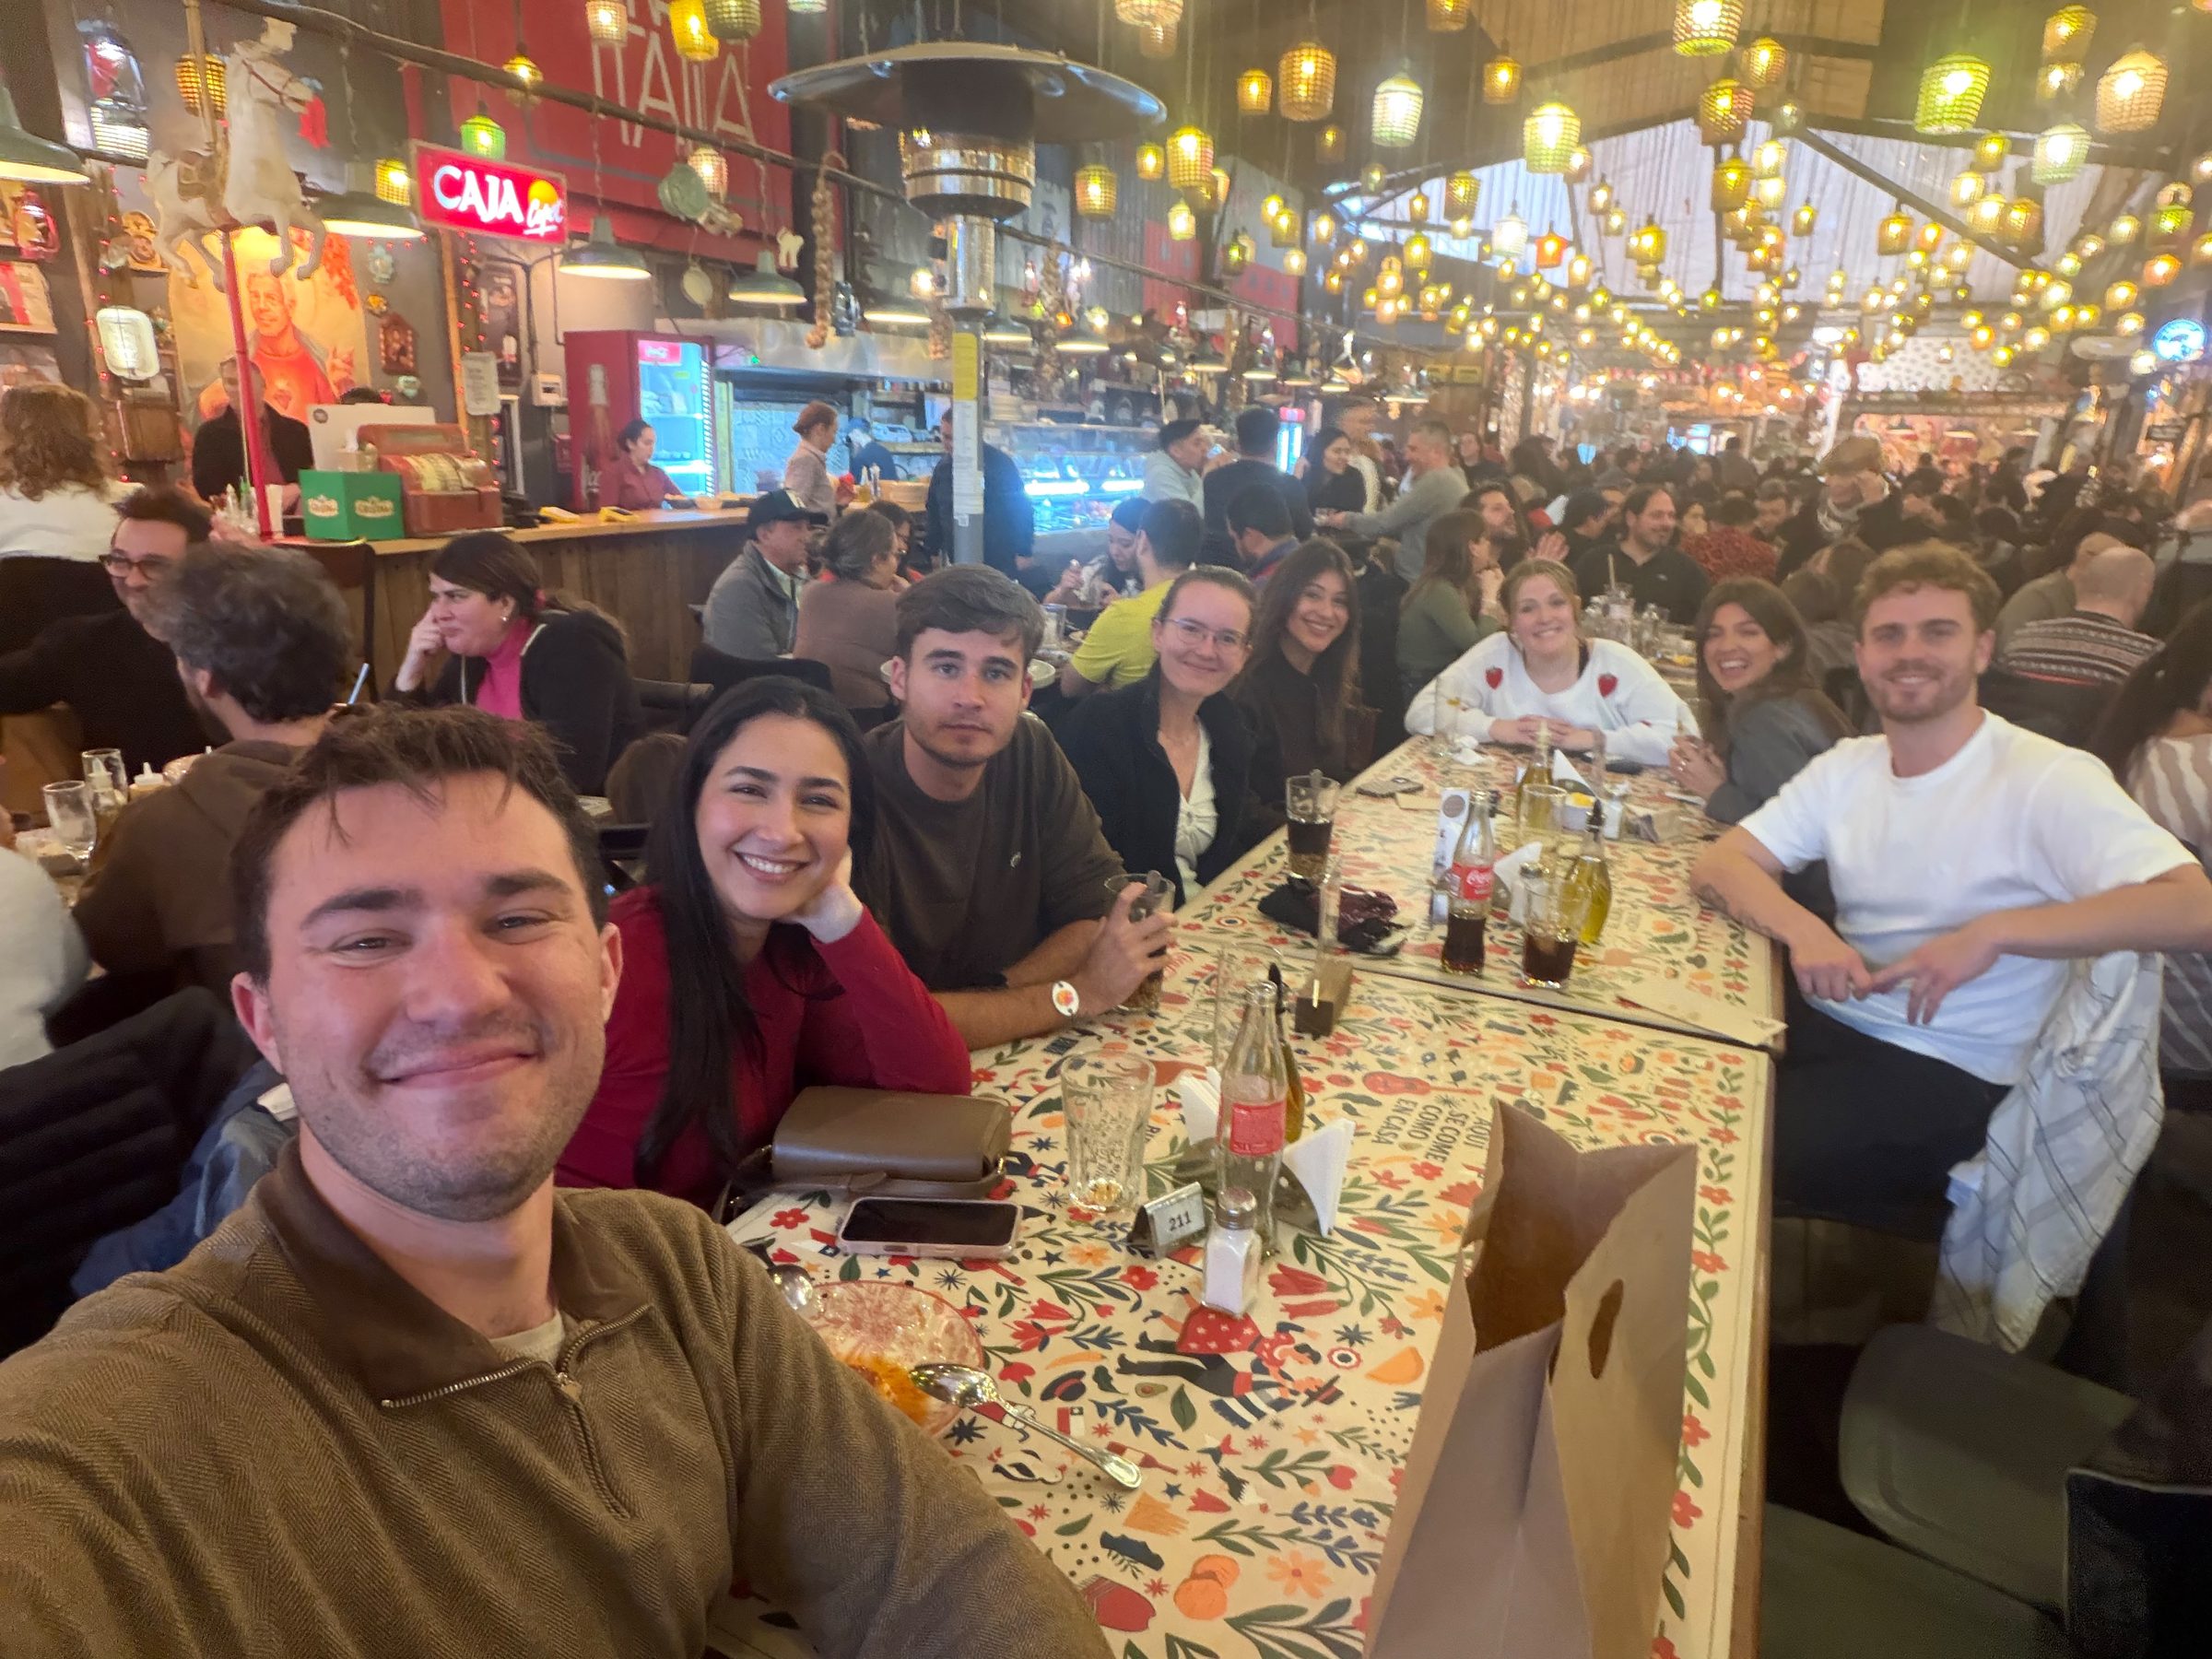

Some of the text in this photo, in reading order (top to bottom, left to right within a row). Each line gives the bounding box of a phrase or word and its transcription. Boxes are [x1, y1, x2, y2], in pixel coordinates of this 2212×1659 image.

[433, 164, 524, 224] CAJA
[1371, 1098, 1418, 1145] EN CASA
[1406, 1104, 1443, 1140] COMO
[1425, 1109, 1469, 1163] SE COME
[1169, 1210, 1192, 1232] 211
